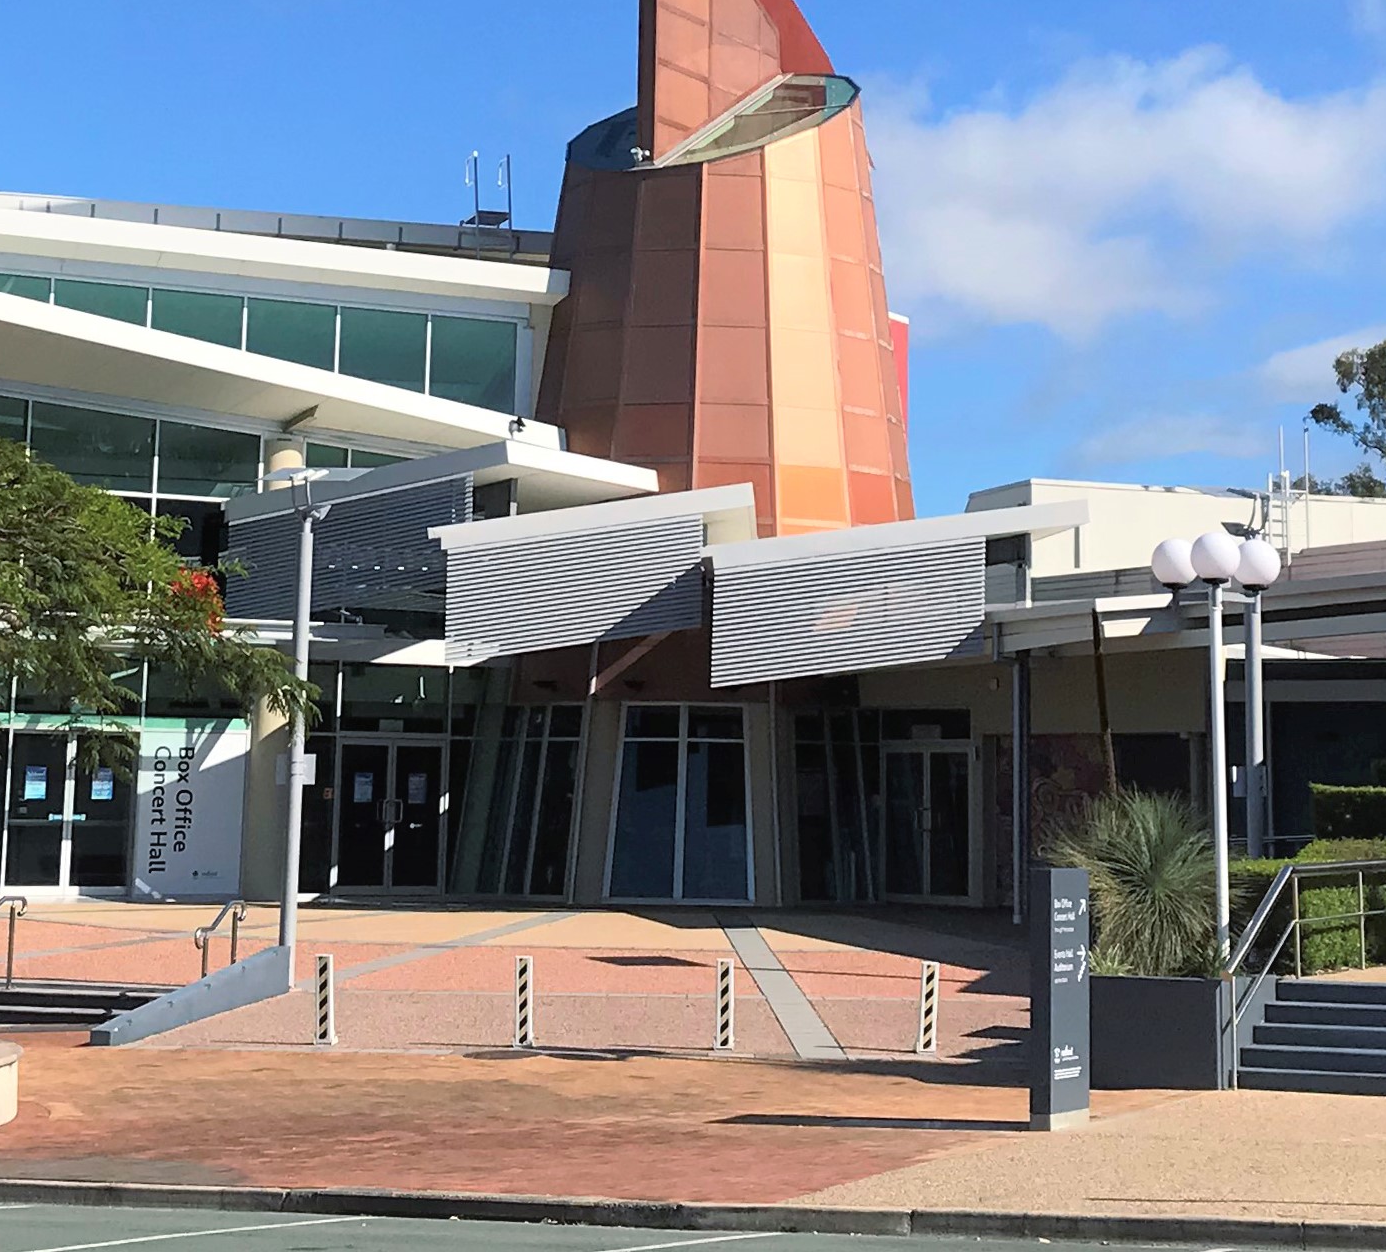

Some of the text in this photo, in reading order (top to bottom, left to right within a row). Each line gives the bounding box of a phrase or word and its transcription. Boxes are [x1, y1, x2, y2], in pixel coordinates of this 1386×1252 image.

[148, 746, 172, 874] Concert Hall
[173, 747, 195, 853] Box Office
